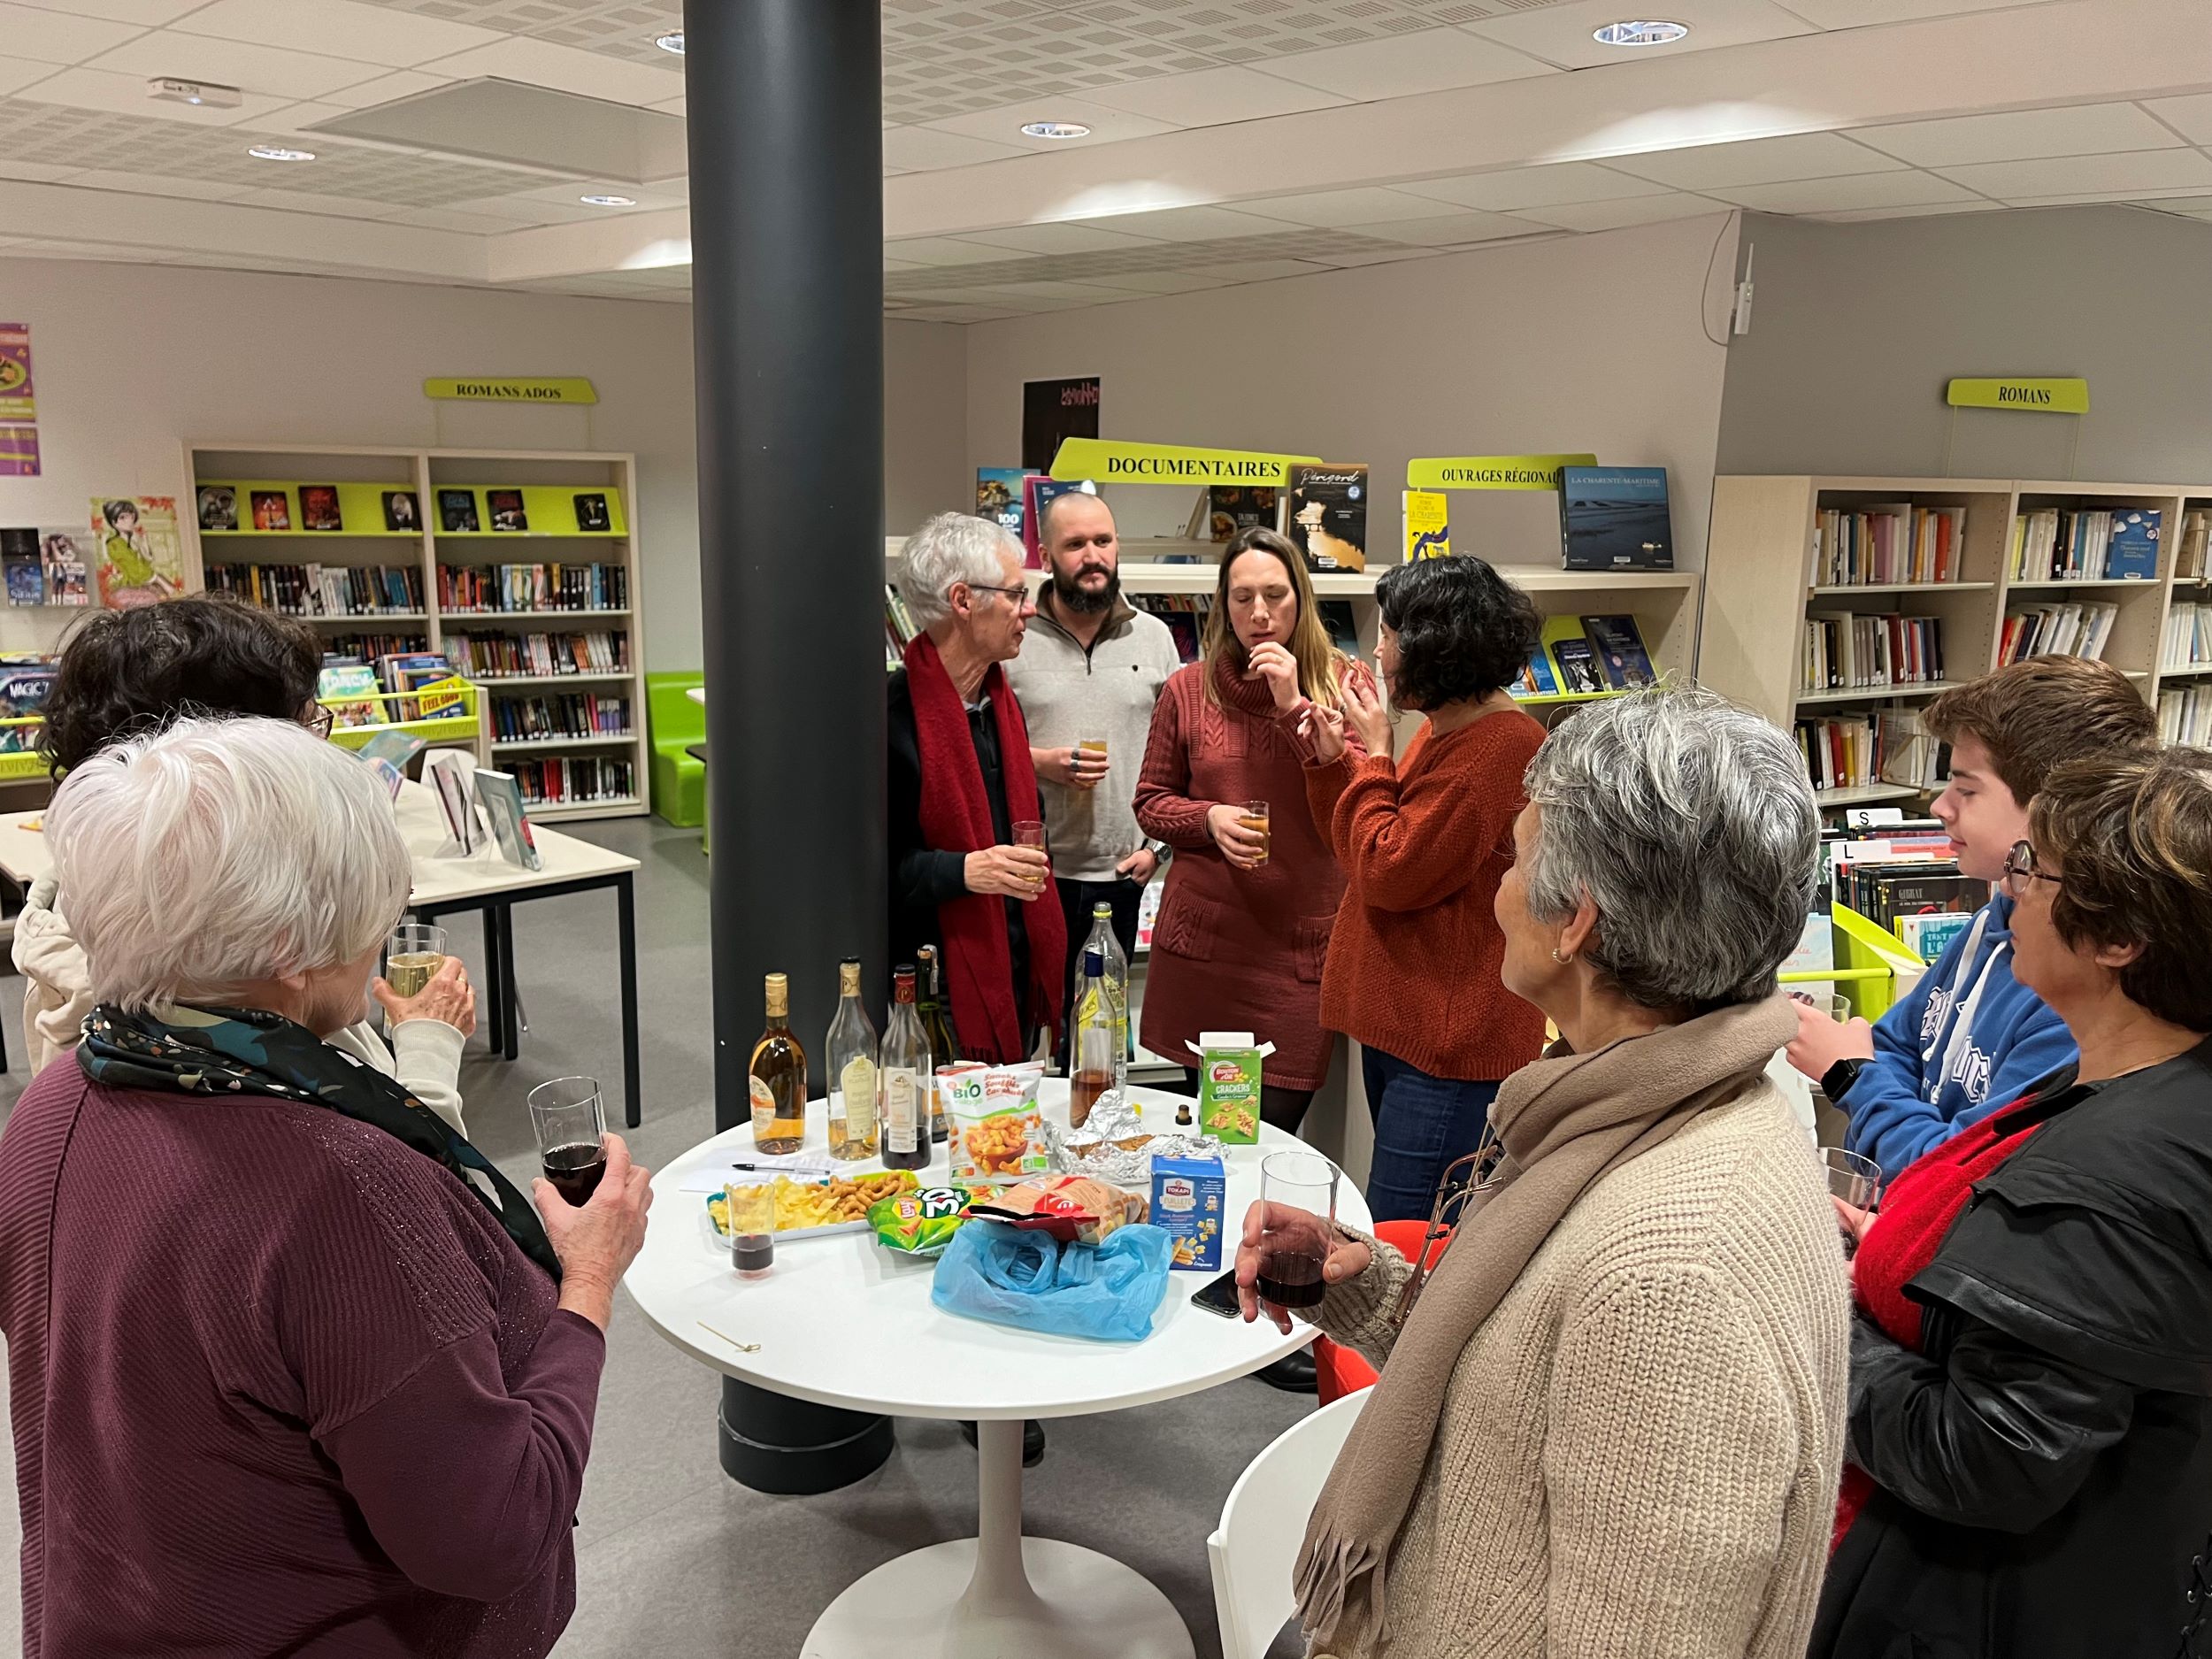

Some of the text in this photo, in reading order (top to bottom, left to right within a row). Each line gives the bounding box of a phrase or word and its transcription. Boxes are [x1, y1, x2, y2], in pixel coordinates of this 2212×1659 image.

[457, 384, 561, 399] ROMANS ADOS
[1999, 386, 2051, 404] ROMANS
[1108, 457, 1281, 478] DOCUMENTAIRES
[1441, 466, 1558, 484] OUVRAGES RÉGIONAU
[1301, 467, 1359, 486] Périgord
[997, 513, 1020, 525] 100
[10, 682, 42, 699] MAGIC
[423, 693, 460, 712] FEEL GOOD
[1859, 811, 1870, 826] S
[1844, 844, 1854, 859] L
[1216, 1084, 1250, 1094] CRACKERS
